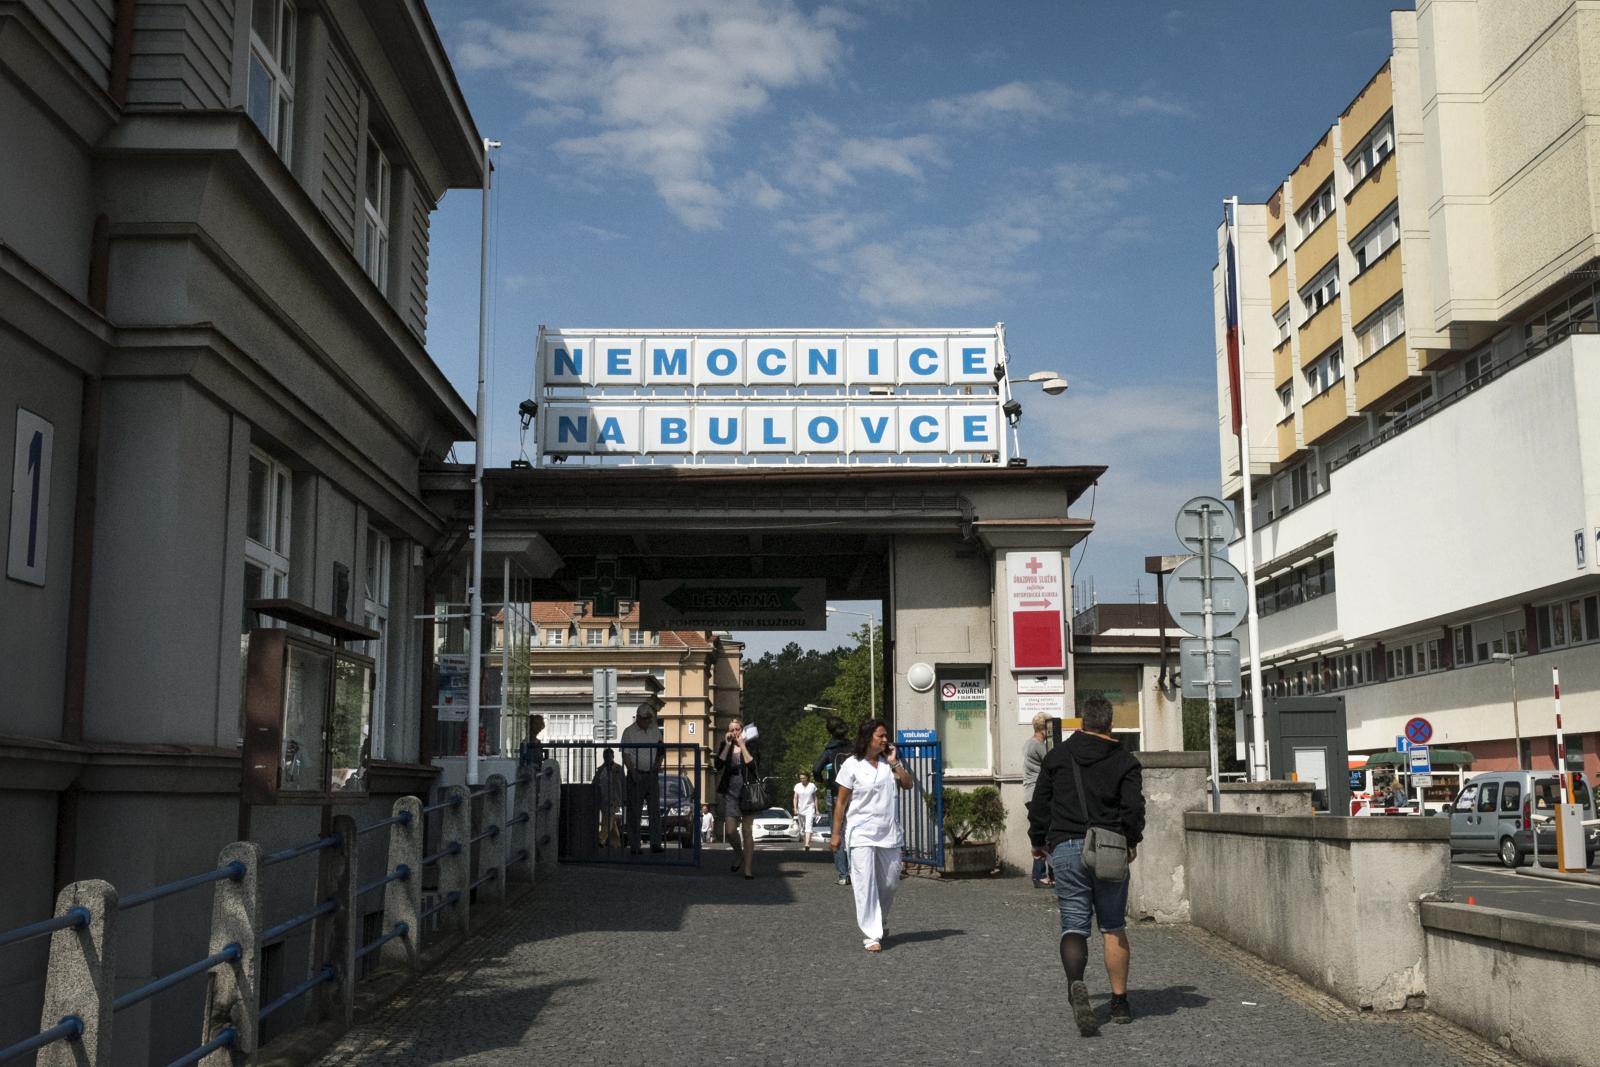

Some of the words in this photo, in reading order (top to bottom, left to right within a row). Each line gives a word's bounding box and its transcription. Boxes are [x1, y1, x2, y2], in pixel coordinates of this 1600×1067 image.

[554, 347, 987, 376] NEMOCNICE
[558, 415, 625, 445] NA
[660, 415, 989, 445] BULOVCE
[27, 430, 42, 568] 1
[689, 723, 695, 733] 3
